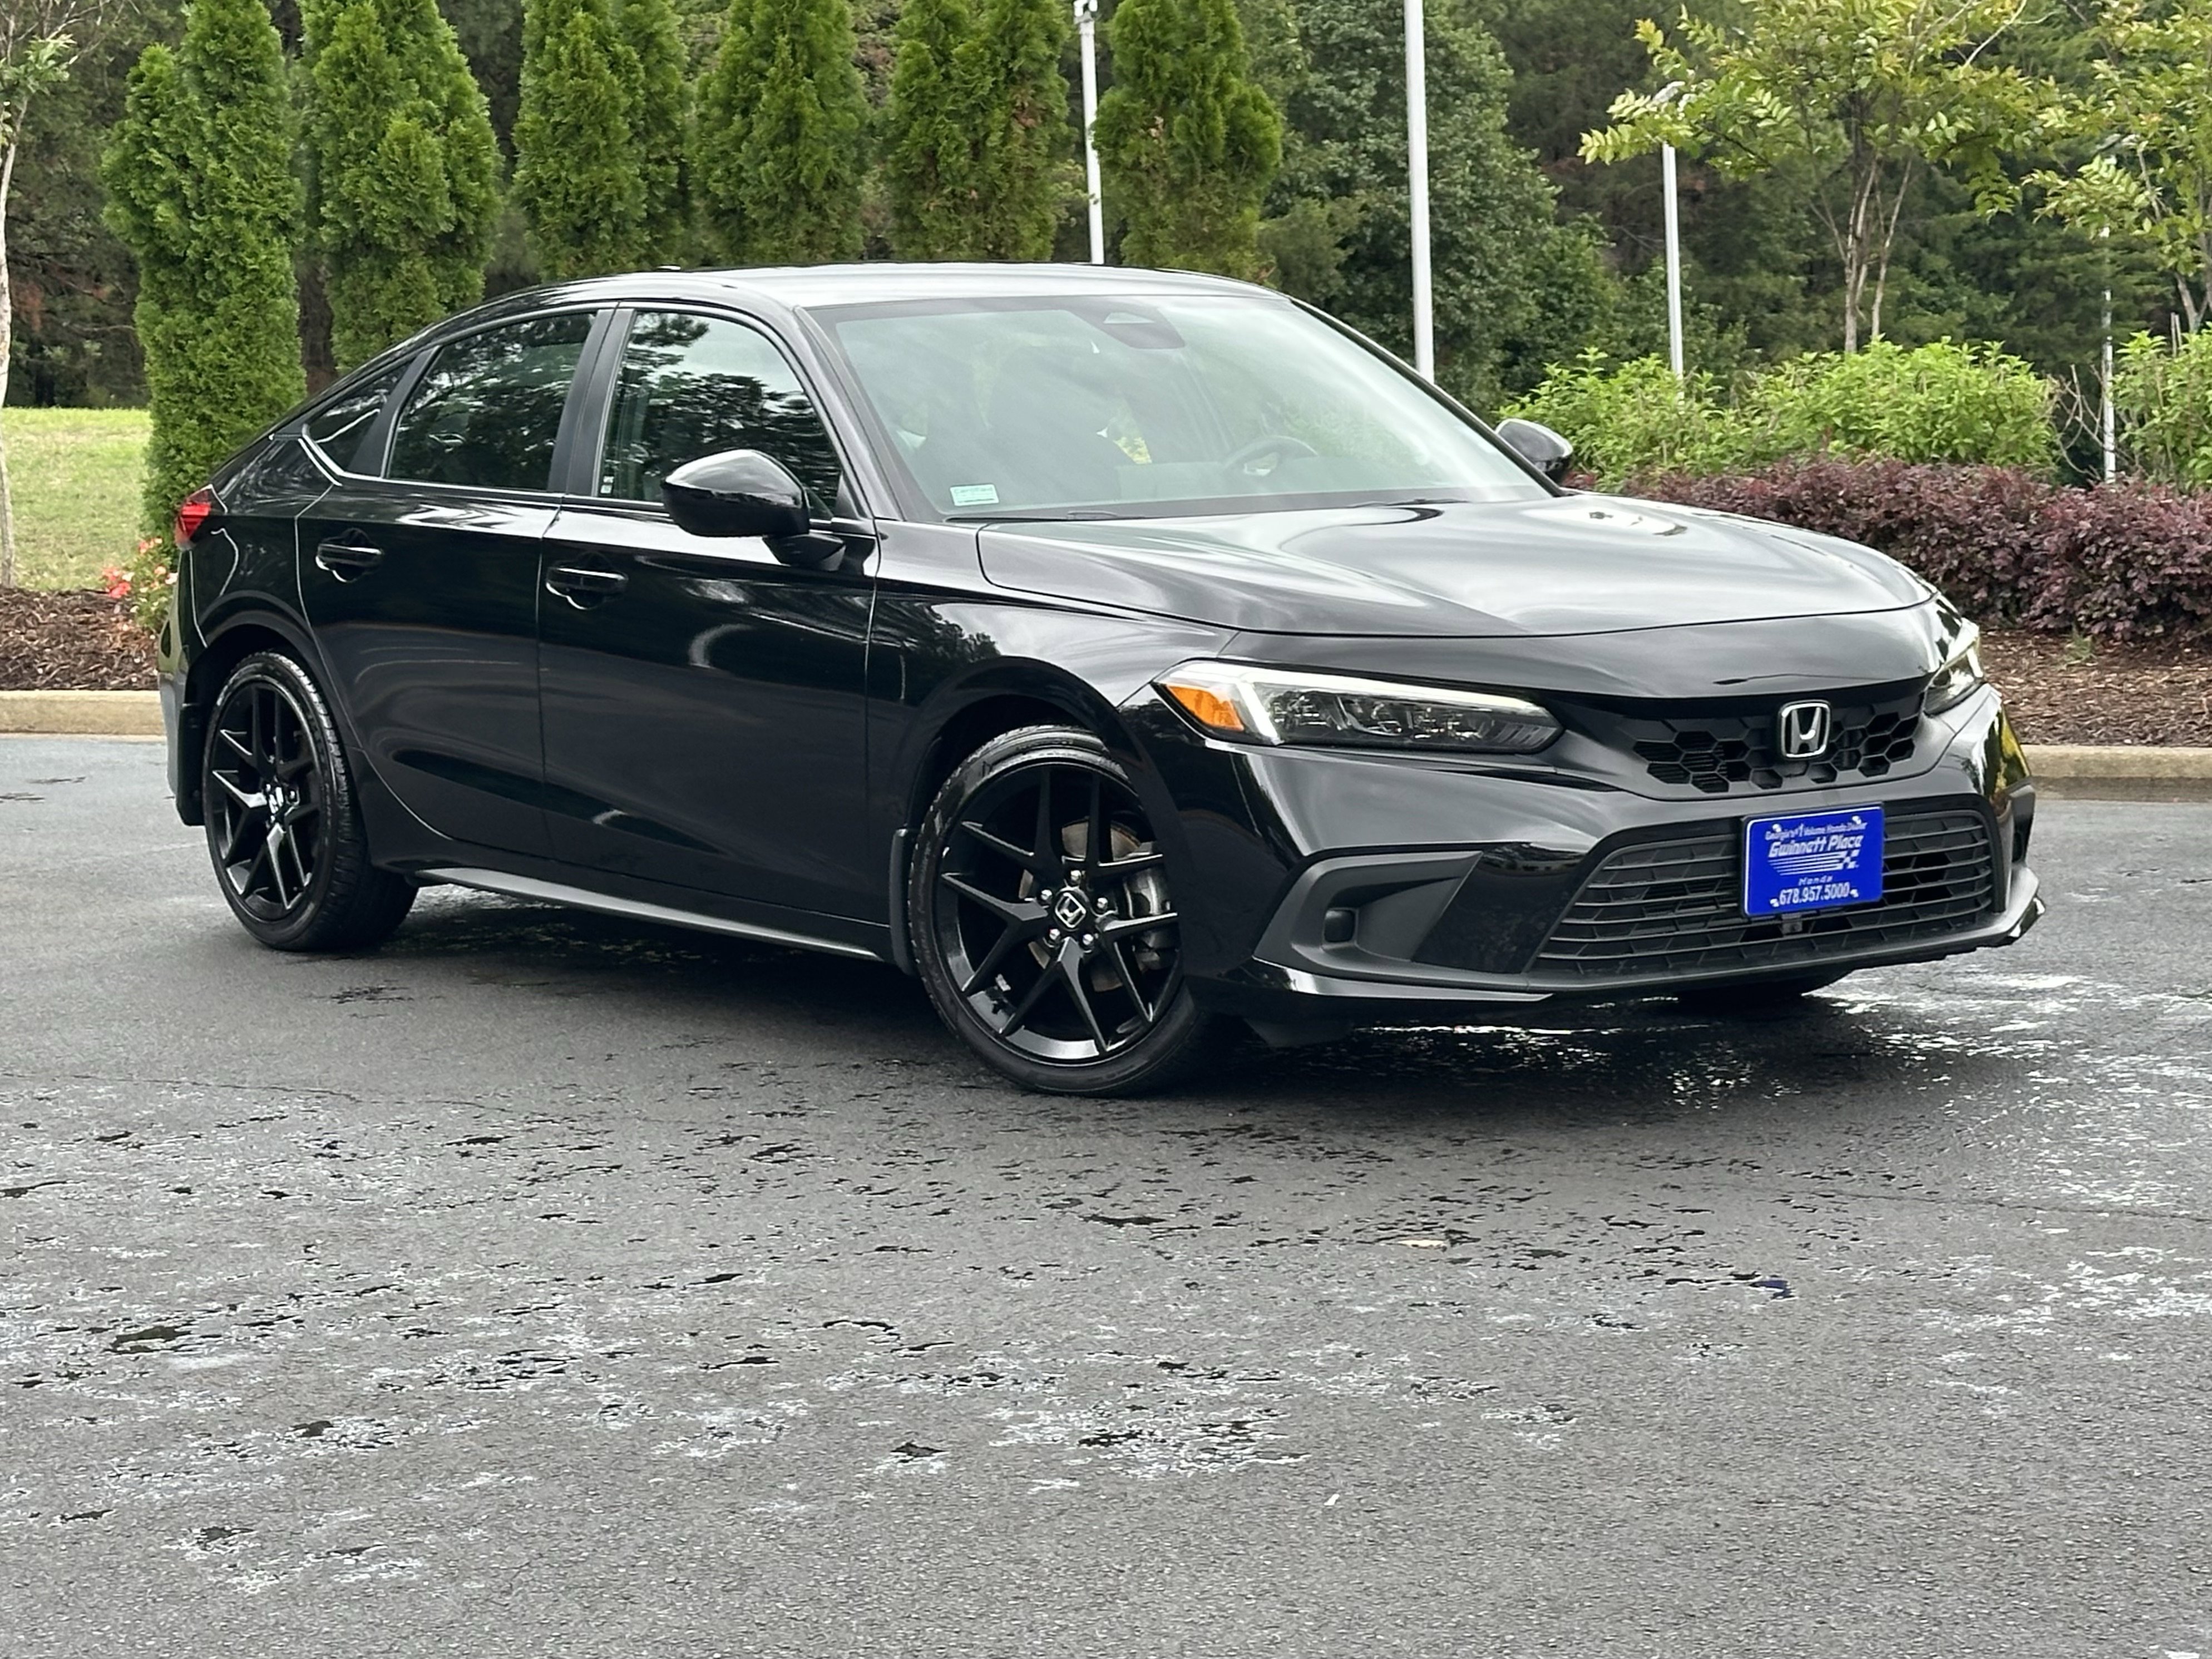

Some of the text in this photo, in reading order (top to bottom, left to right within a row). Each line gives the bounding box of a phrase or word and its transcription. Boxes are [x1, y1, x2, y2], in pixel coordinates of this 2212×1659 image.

[1768, 835, 1864, 857] Gwinnett Place
[1798, 875, 1833, 886] Honda
[1779, 881, 1850, 905] 678.957.5000
